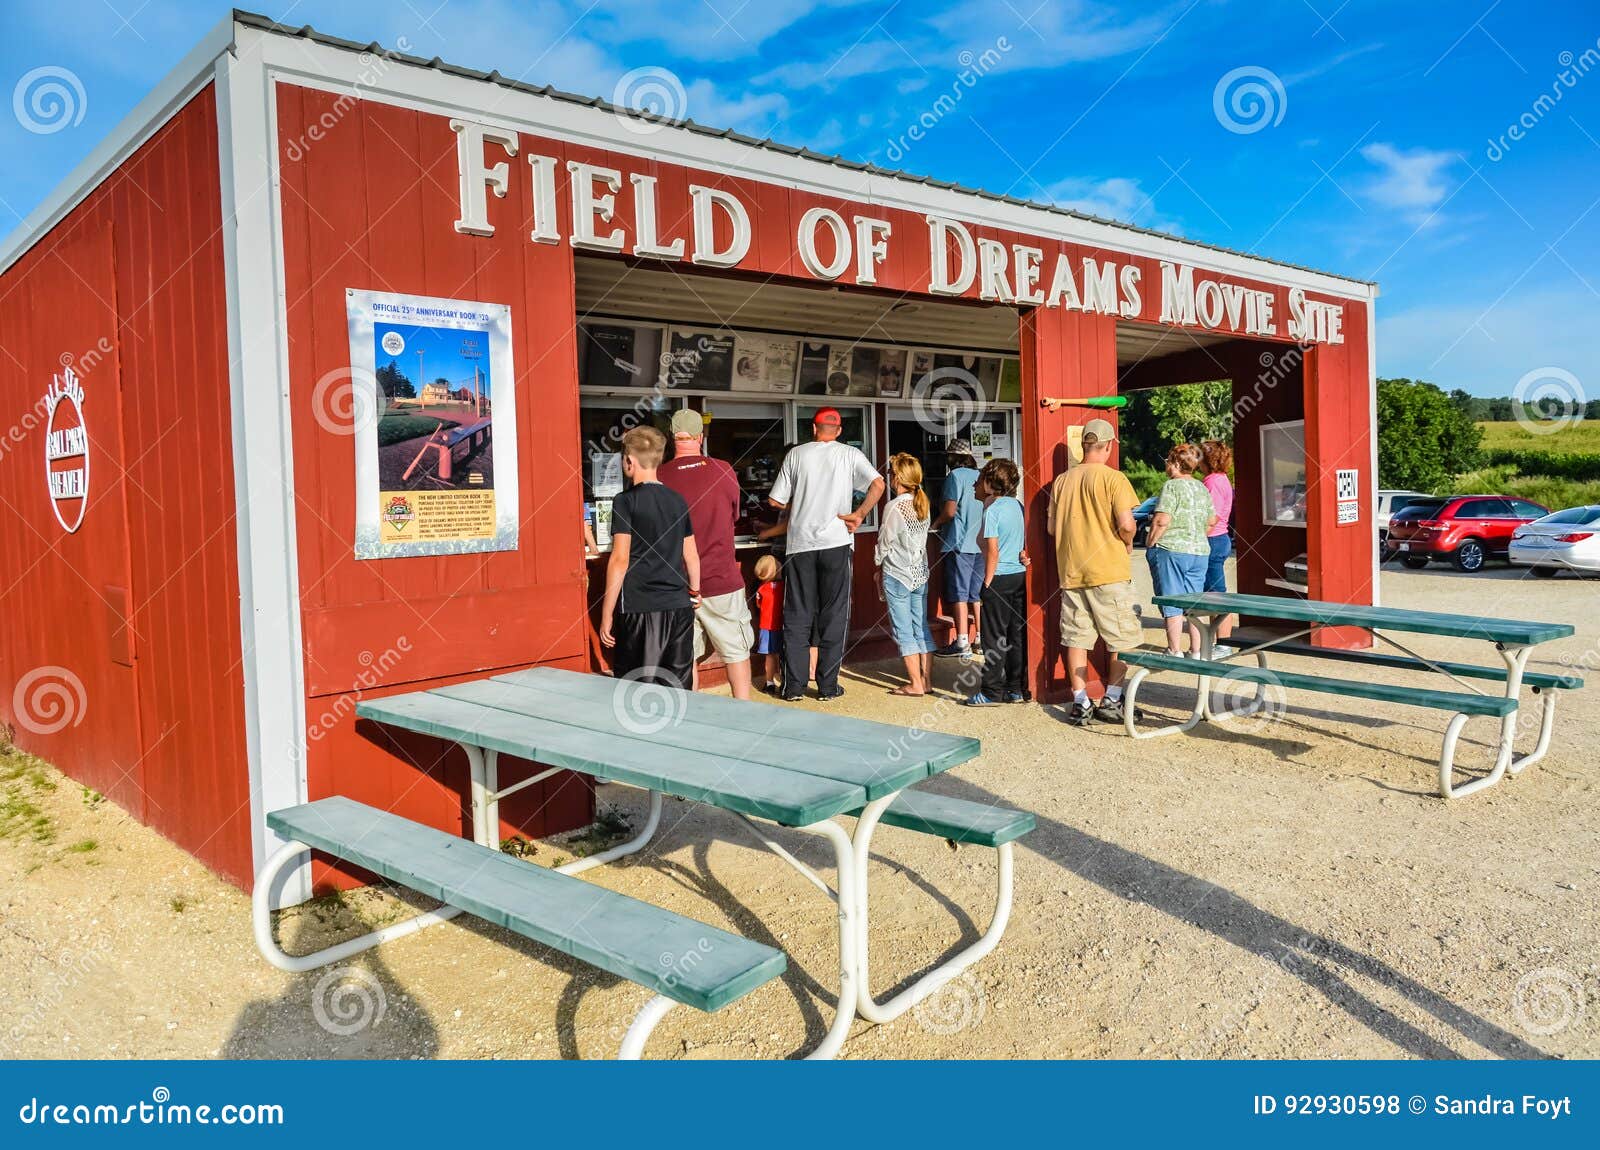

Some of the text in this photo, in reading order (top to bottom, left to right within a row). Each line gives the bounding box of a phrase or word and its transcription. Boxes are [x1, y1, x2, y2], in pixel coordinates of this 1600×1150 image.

[449, 118, 752, 269] FIELD
[926, 214, 1141, 320] DREAMS
[1159, 260, 1277, 336] MOVIE
[1287, 287, 1345, 345] SITE
[372, 303, 400, 313] OFFICIAL
[416, 307, 458, 318] ANNIVERSARY
[460, 312, 476, 320] BOOK
[51, 468, 84, 498] HEAVEN
[1338, 472, 1356, 498] OPEN
